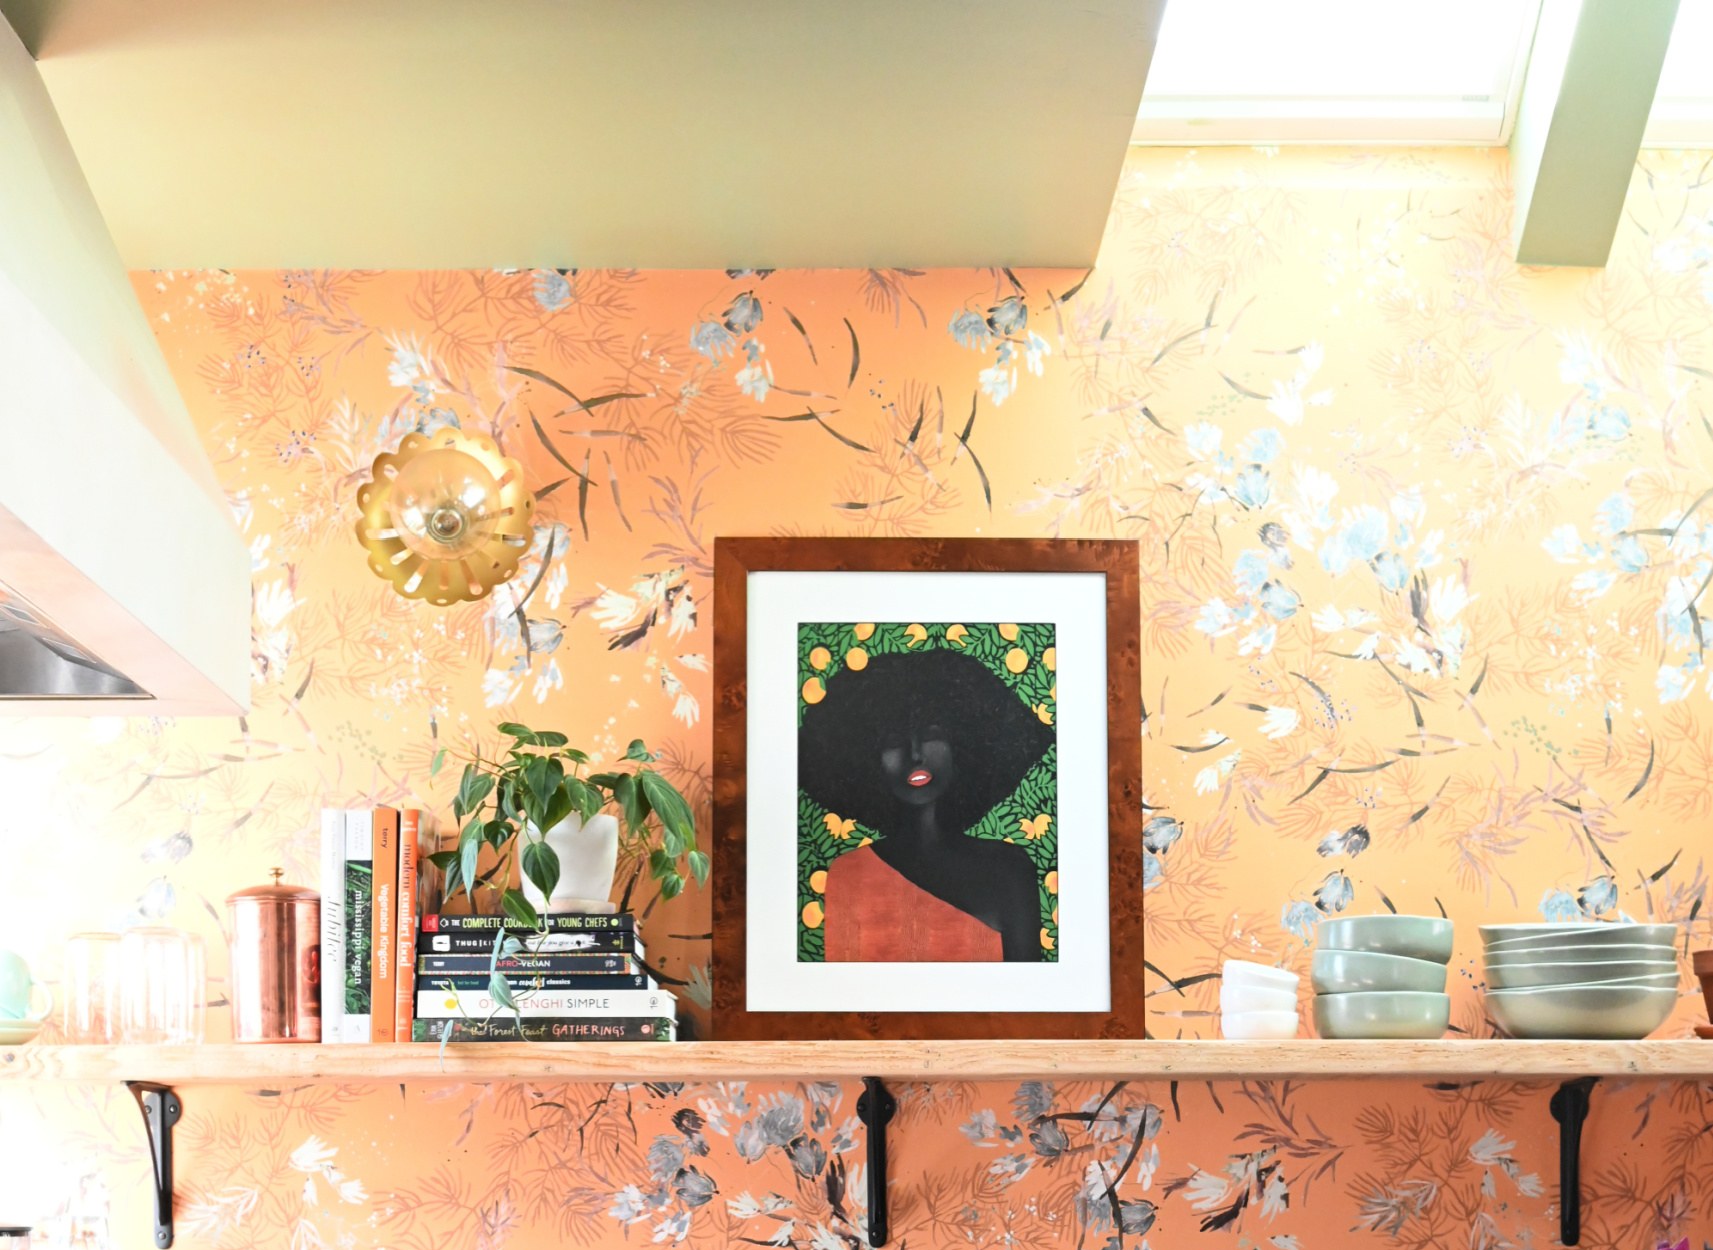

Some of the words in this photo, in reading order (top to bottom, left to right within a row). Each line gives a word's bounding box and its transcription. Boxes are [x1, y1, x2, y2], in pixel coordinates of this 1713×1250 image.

[402, 844, 414, 890] modern
[352, 890, 364, 950] mississippi
[378, 884, 389, 933] Vegetable
[400, 891, 413, 938] comfort
[451, 919, 460, 927] THE
[462, 917, 501, 928] COMPLETE
[557, 917, 582, 928] YOUNG
[585, 917, 607, 928] CHEFS
[352, 954, 363, 985] vegan
[378, 935, 389, 979] Kingdom
[399, 941, 412, 967] food
[479, 998, 563, 1009] OTLENGHI
[567, 998, 610, 1009] SIMPLE
[489, 1023, 516, 1037] Forest
[552, 1023, 626, 1038] GATHERINGS
